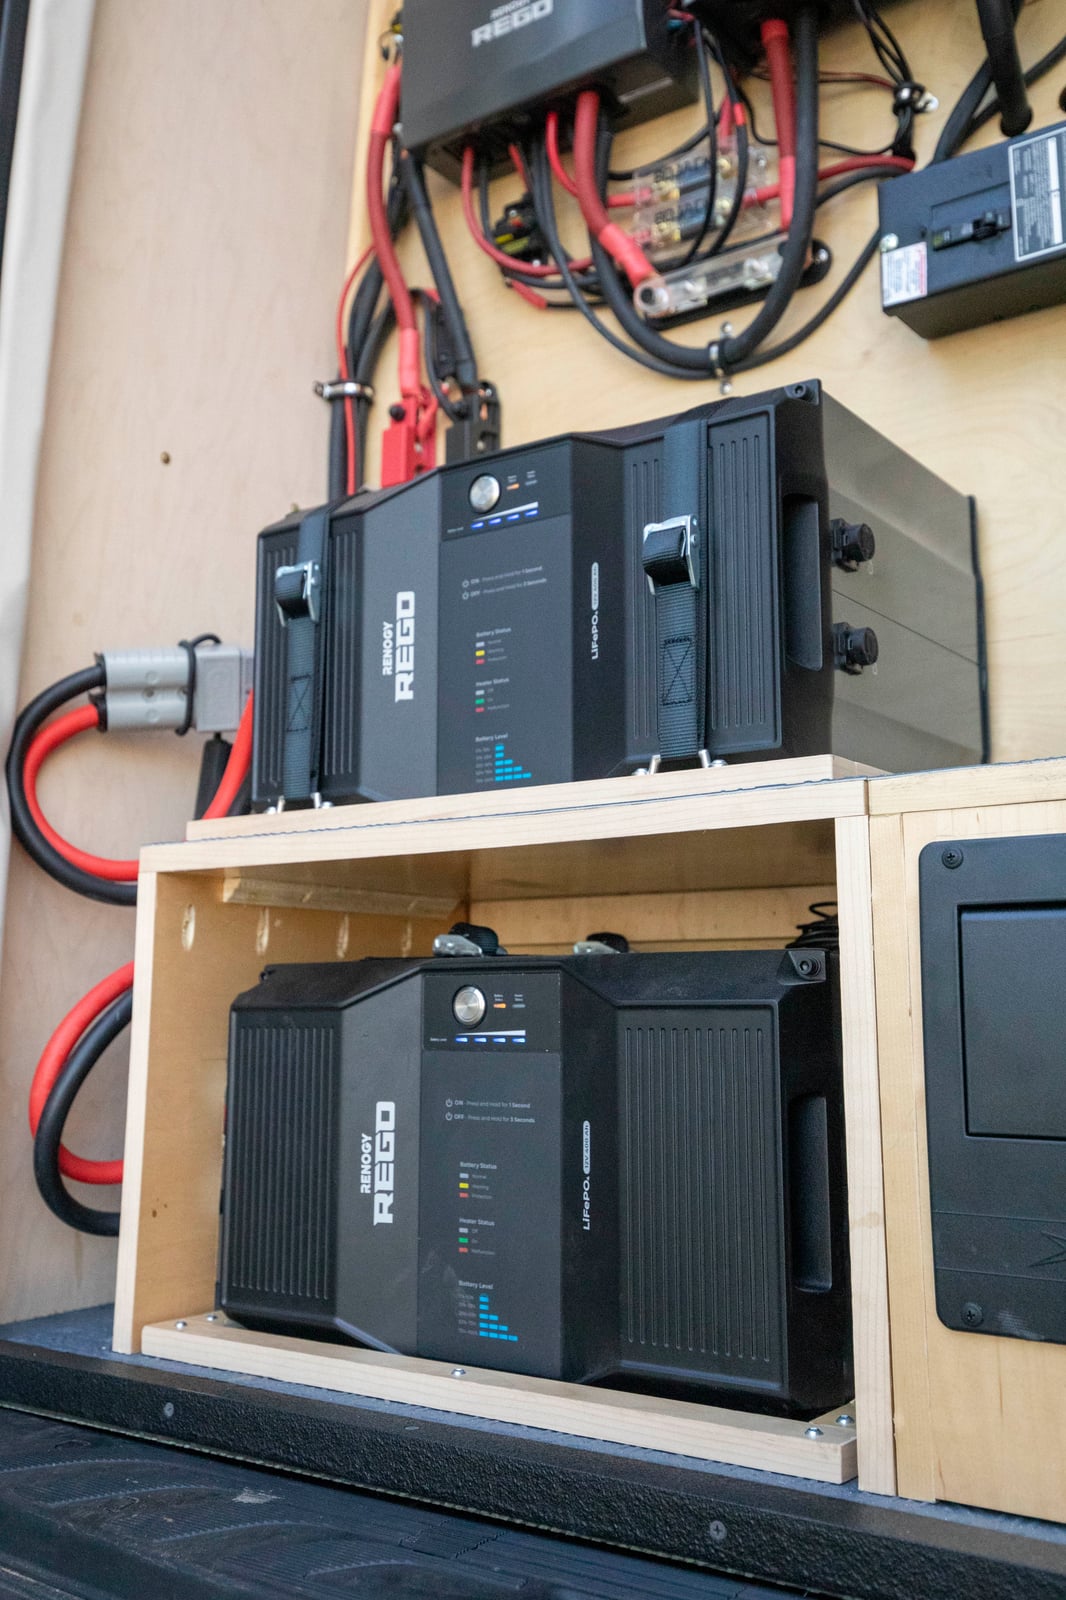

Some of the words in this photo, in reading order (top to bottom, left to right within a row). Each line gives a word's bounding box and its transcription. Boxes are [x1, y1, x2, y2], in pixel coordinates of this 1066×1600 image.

[471, 0, 554, 48] REGO
[382, 621, 394, 676] RENOGY
[395, 590, 415, 703] REGO
[360, 1133, 372, 1194] RENOGY
[373, 1101, 396, 1226] REGO
